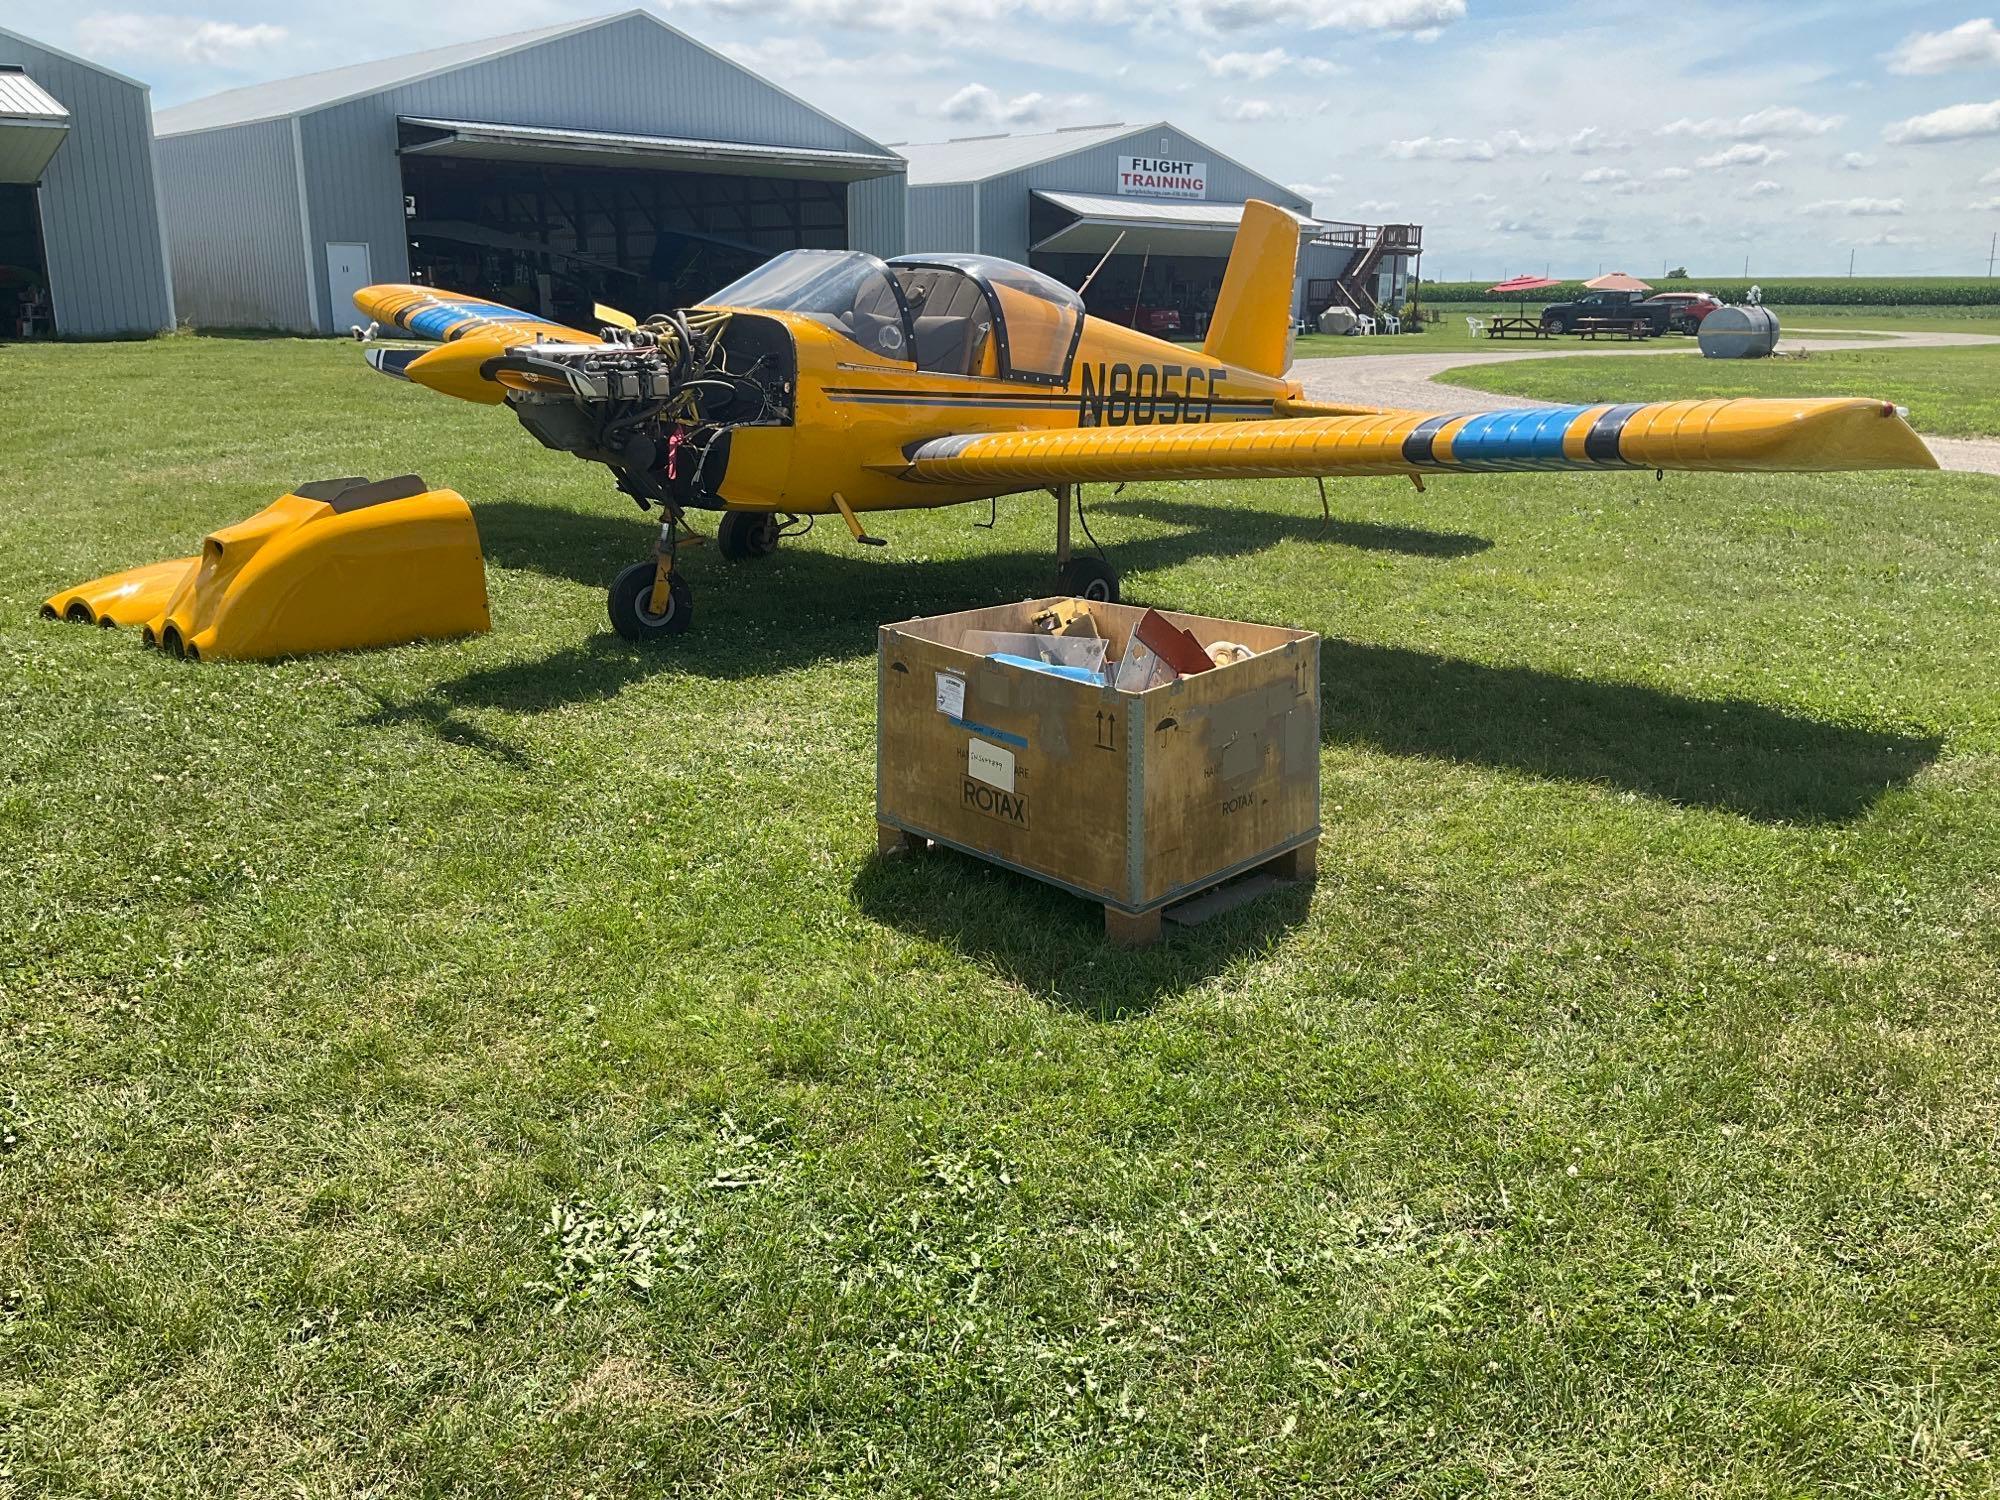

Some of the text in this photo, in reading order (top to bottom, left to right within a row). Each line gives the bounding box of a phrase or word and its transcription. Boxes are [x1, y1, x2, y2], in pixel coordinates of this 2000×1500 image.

[1132, 158, 1193, 175] FLIGHT
[1121, 173, 1204, 190] TRAINING
[1078, 362, 1227, 428] N805CF
[963, 780, 1025, 823] ROTAX
[1222, 791, 1254, 817] ROTAX
